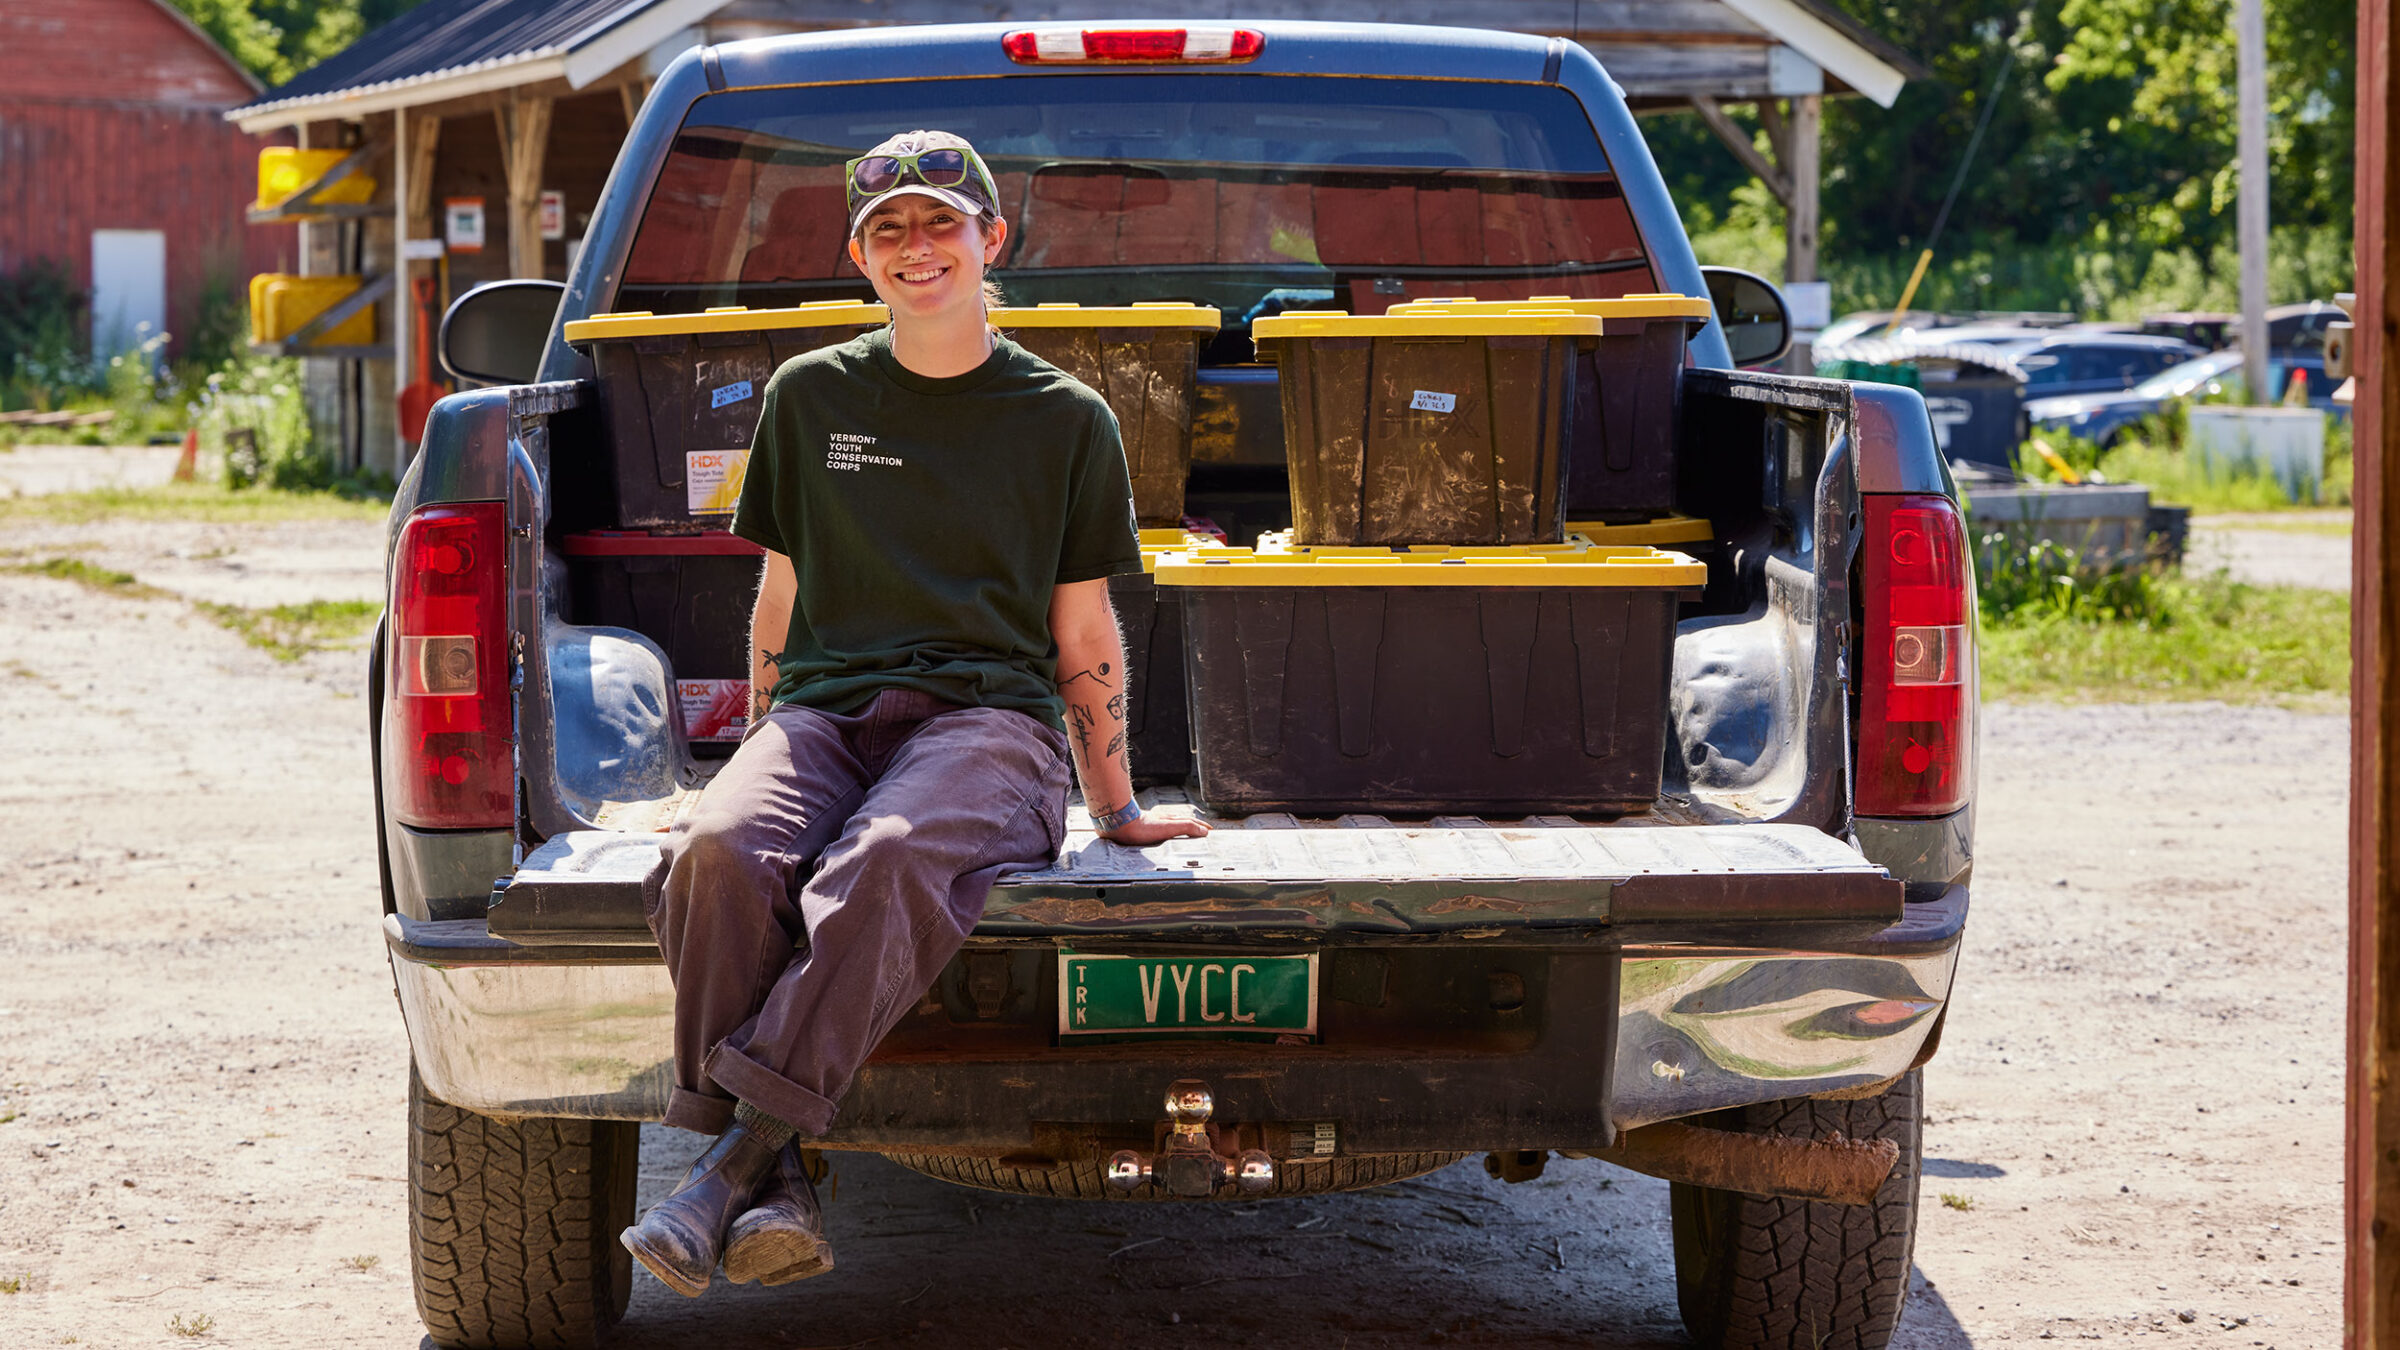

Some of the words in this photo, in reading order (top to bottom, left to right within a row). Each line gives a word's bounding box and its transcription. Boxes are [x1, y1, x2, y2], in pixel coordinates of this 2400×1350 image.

[829, 433, 877, 444] VERMONT
[828, 442, 862, 453] YOUTH
[691, 455, 724, 469] HDX
[827, 451, 903, 467] CONSERVATION
[826, 460, 861, 472] CORPS
[678, 684, 712, 697] HDX
[1076, 965, 1088, 1025] TRK
[1138, 963, 1256, 1024] VYCC
